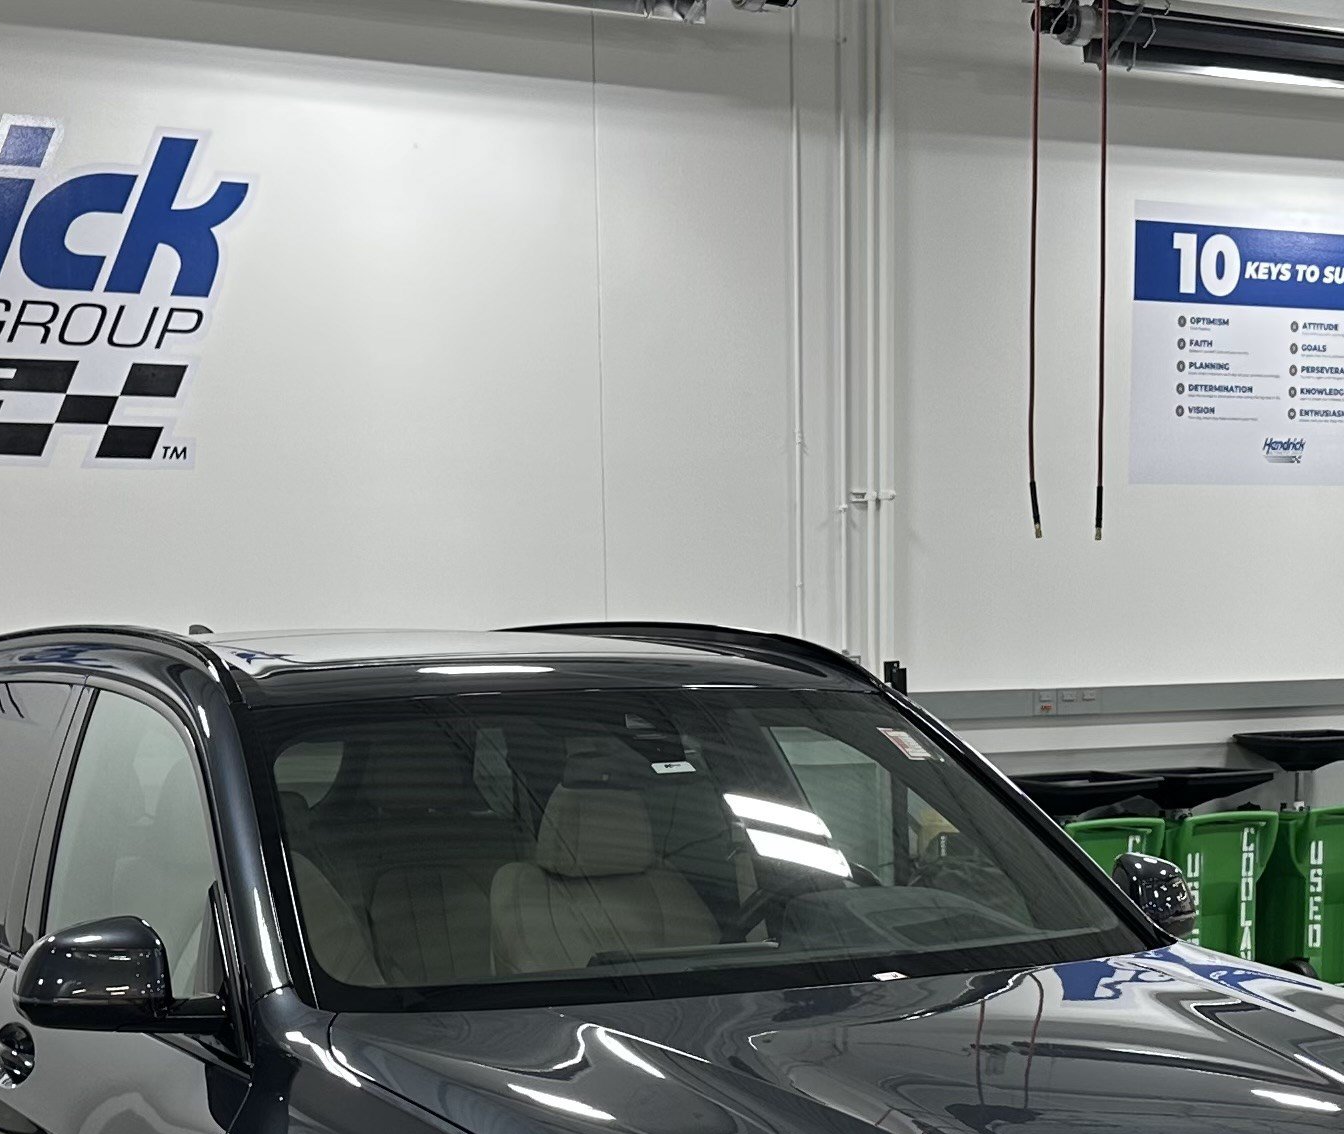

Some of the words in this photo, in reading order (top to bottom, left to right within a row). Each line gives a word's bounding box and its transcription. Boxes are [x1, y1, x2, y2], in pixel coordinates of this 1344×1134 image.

[1173, 232, 1241, 297] 10
[1244, 261, 1291, 281] KEYS
[1296, 264, 1320, 283] TO
[1189, 316, 1230, 326] OPTIMISM
[1302, 322, 1339, 331] ATTITUDE
[1189, 339, 1213, 347] FAITH
[1301, 344, 1327, 352] GOALS
[1188, 361, 1230, 371] PLANNING
[1188, 383, 1253, 393] DETERMINATION
[1188, 406, 1215, 414] VISION
[1308, 840, 1324, 948] USED
